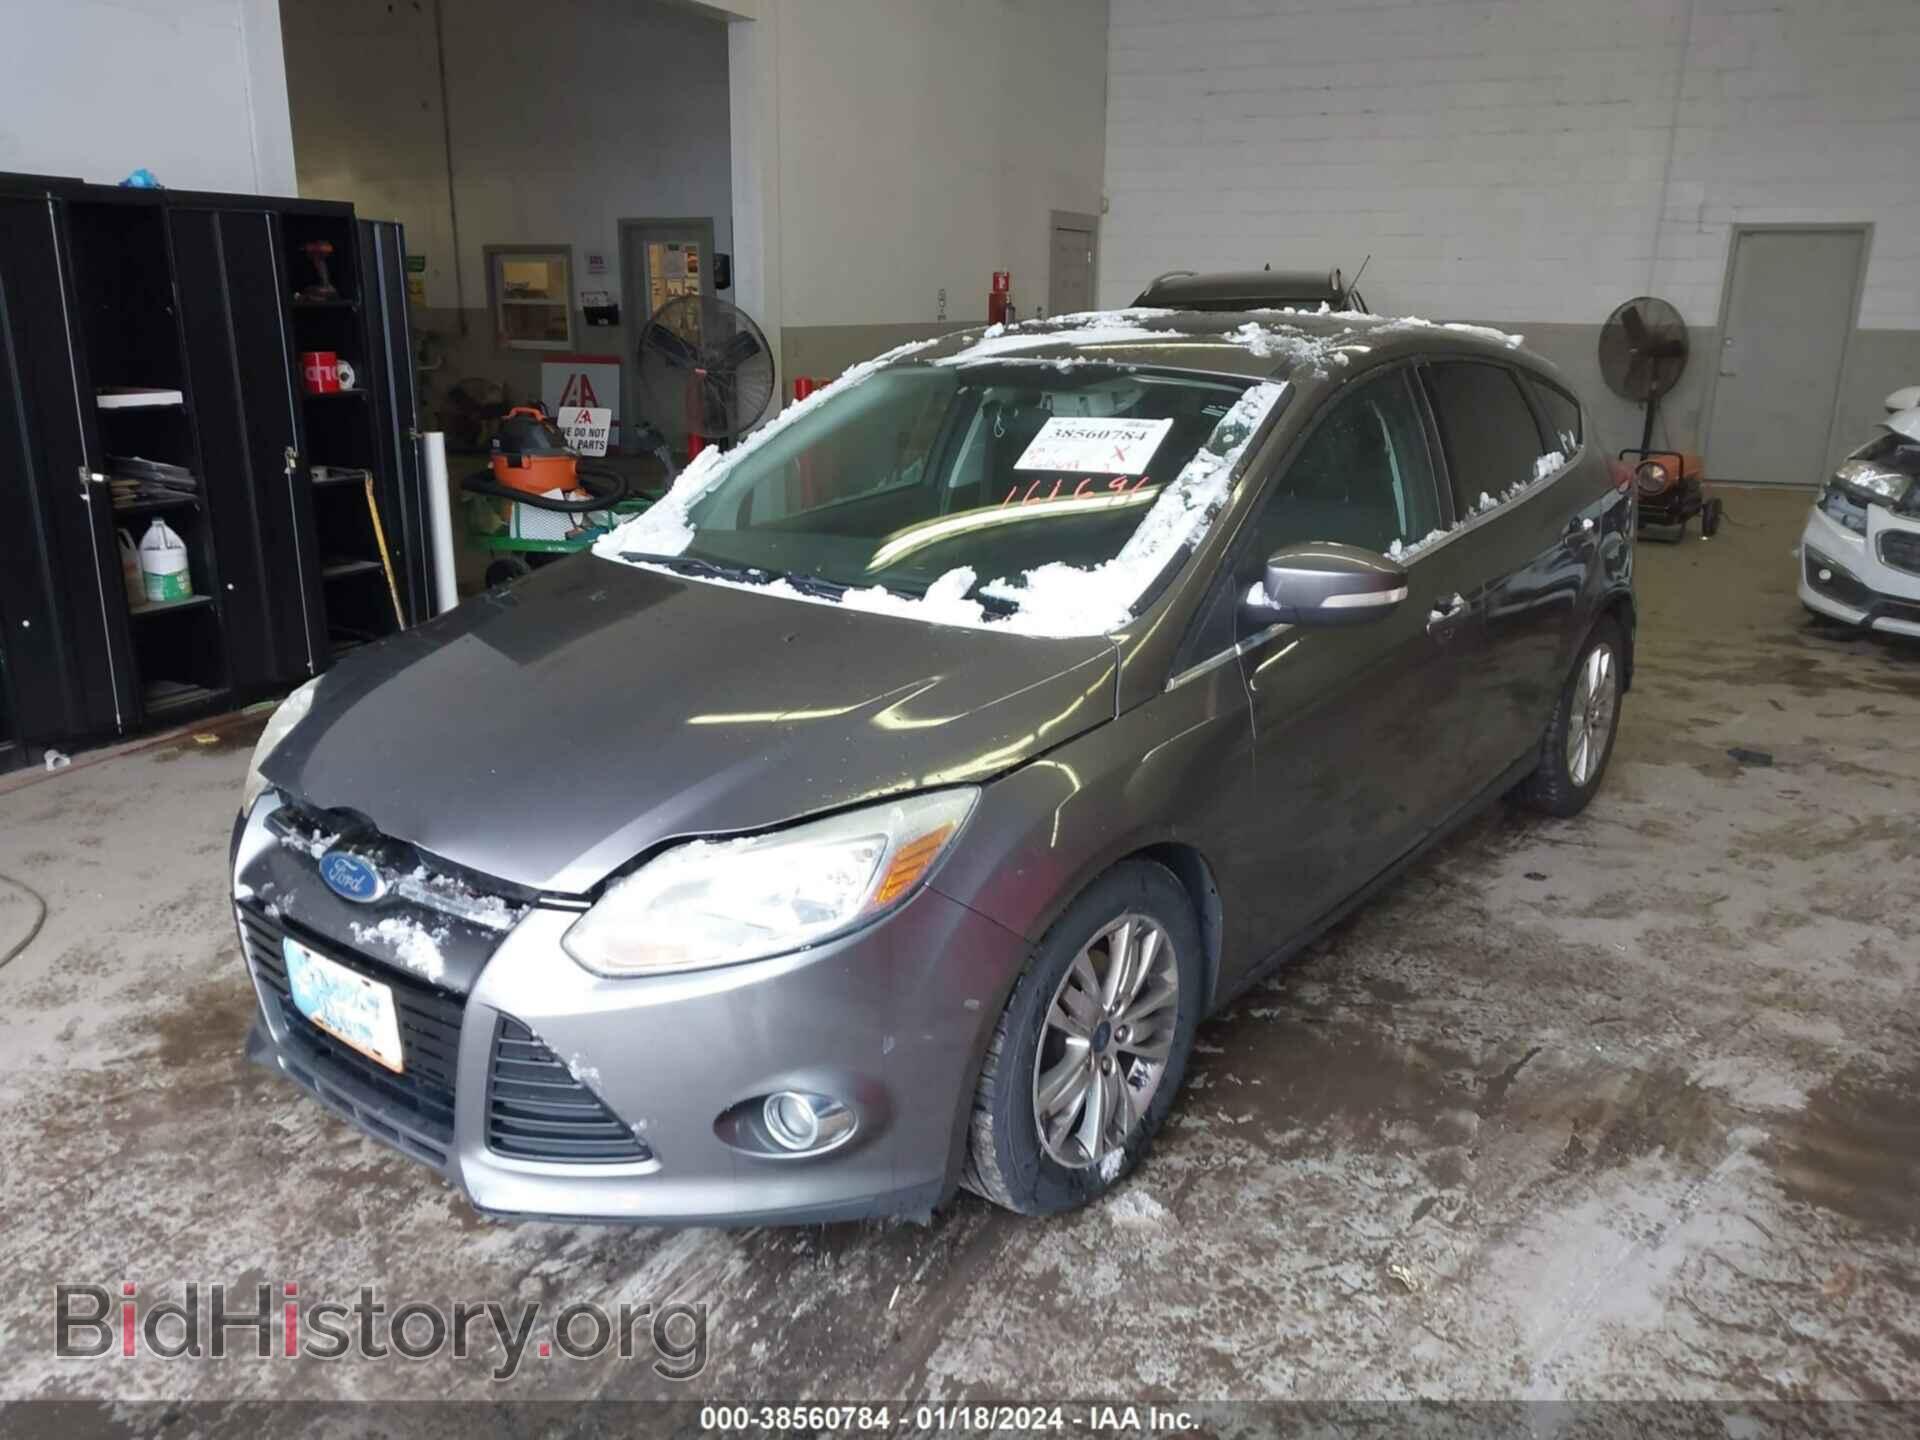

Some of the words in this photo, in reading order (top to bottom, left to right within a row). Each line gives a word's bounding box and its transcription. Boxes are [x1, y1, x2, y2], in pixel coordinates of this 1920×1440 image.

[574, 428, 586, 438] DO
[588, 428, 607, 439] NOT
[1050, 427, 1148, 441] 38560784
[578, 440, 605, 450] PARTS
[328, 858, 366, 891] Ford
